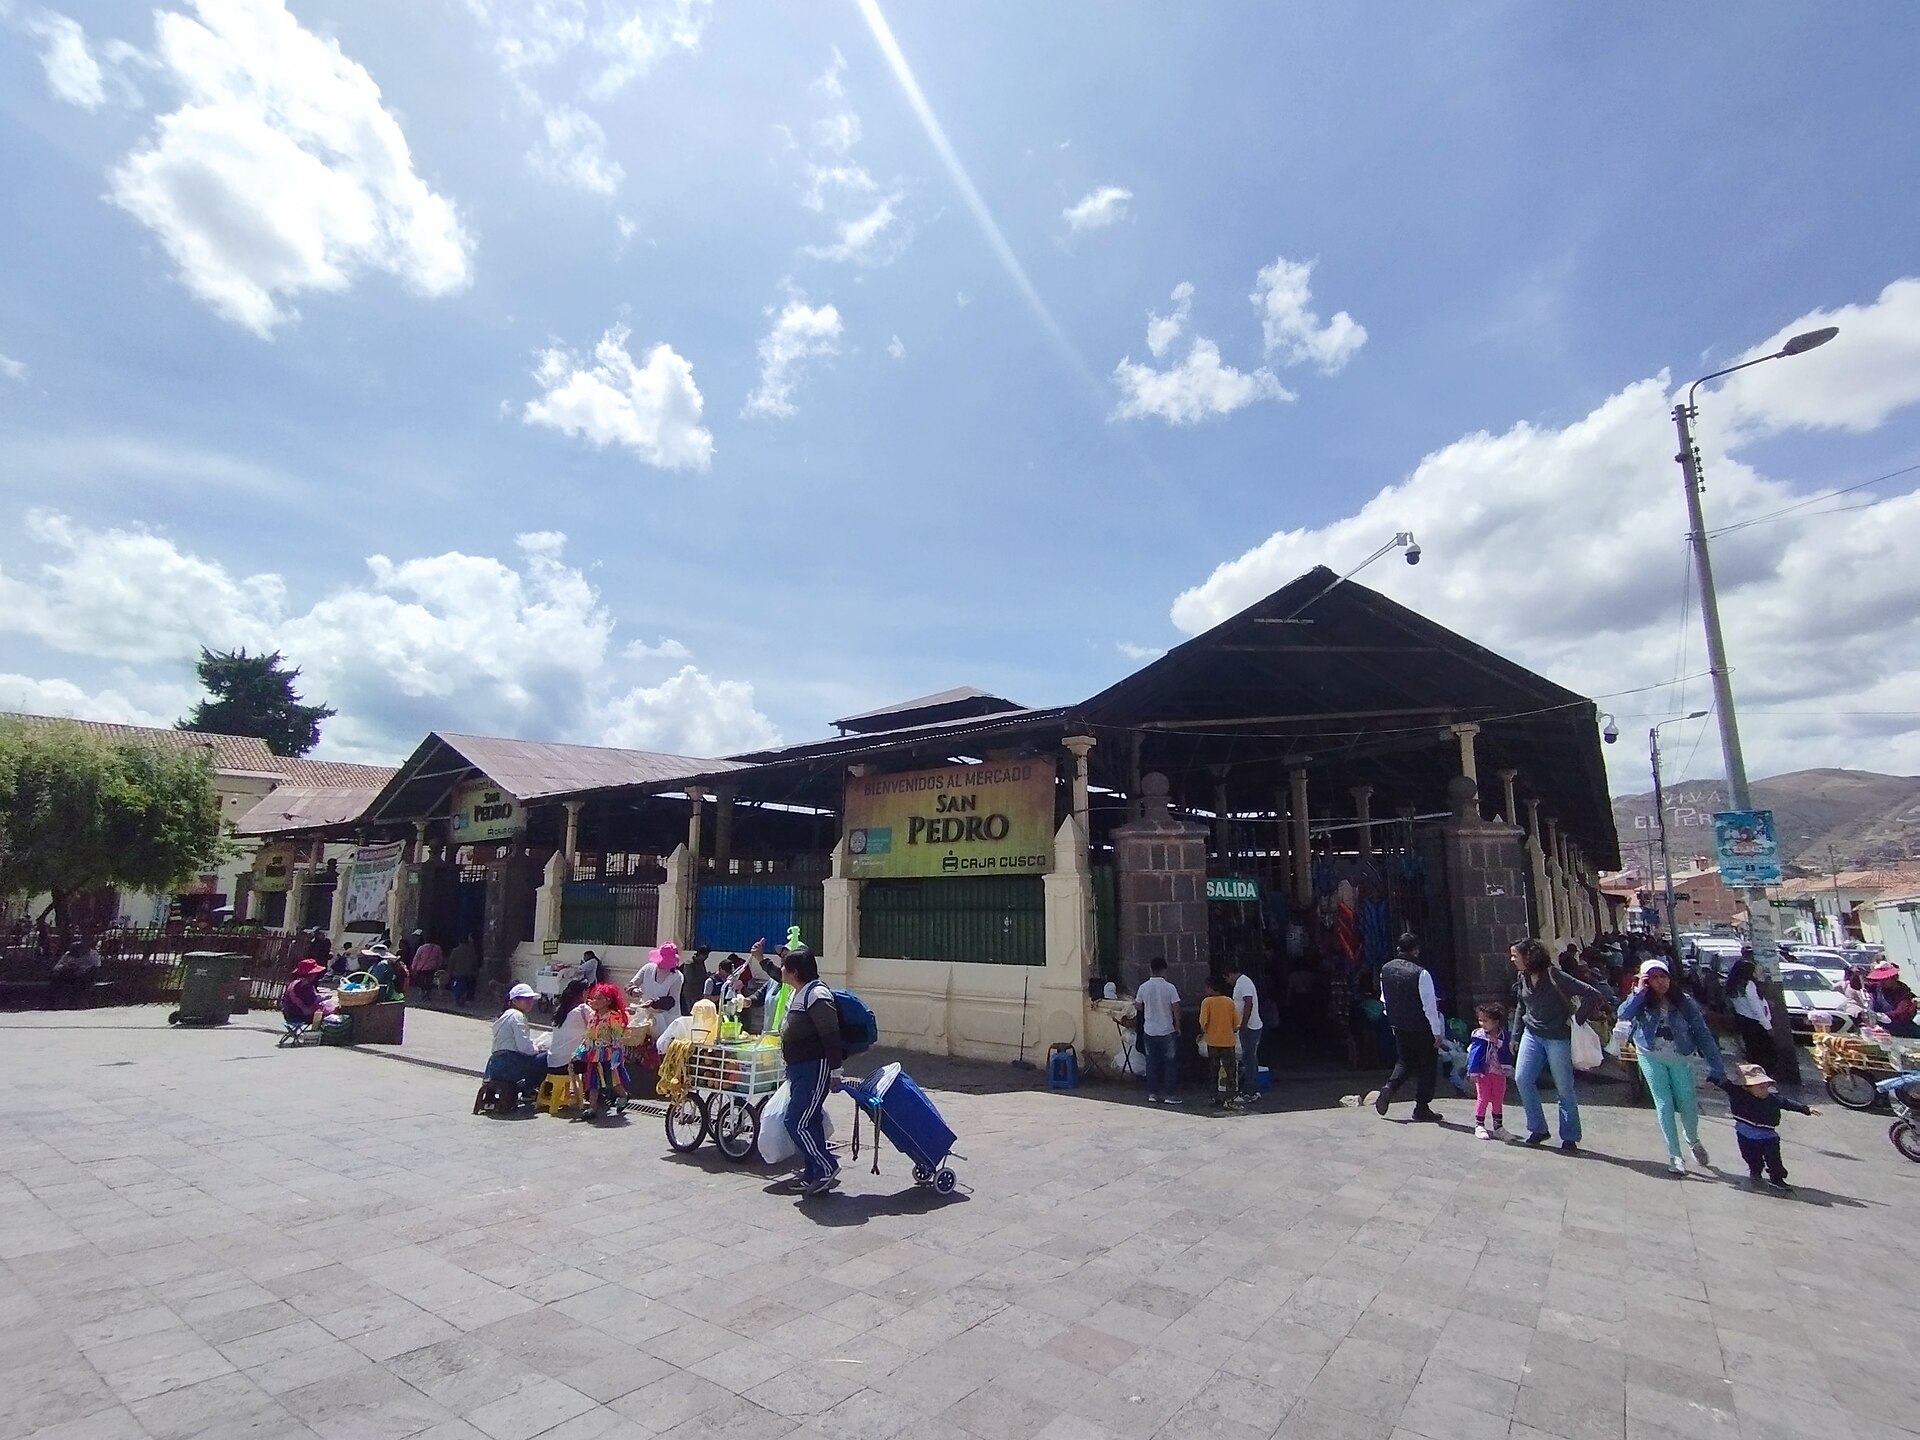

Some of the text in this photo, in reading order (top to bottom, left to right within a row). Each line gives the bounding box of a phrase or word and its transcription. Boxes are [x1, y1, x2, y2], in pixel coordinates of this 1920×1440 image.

[864, 766, 1032, 796] BIENVENIDOS AL MERCADO
[936, 794, 977, 813] SAN
[1662, 790, 1722, 805] VIVA
[474, 803, 513, 822] PEDRO
[1670, 807, 1714, 828] PER
[907, 813, 1010, 845] PEDRO
[961, 855, 1046, 869] CAJA CUSCO
[1206, 881, 1257, 898] SALIDA
